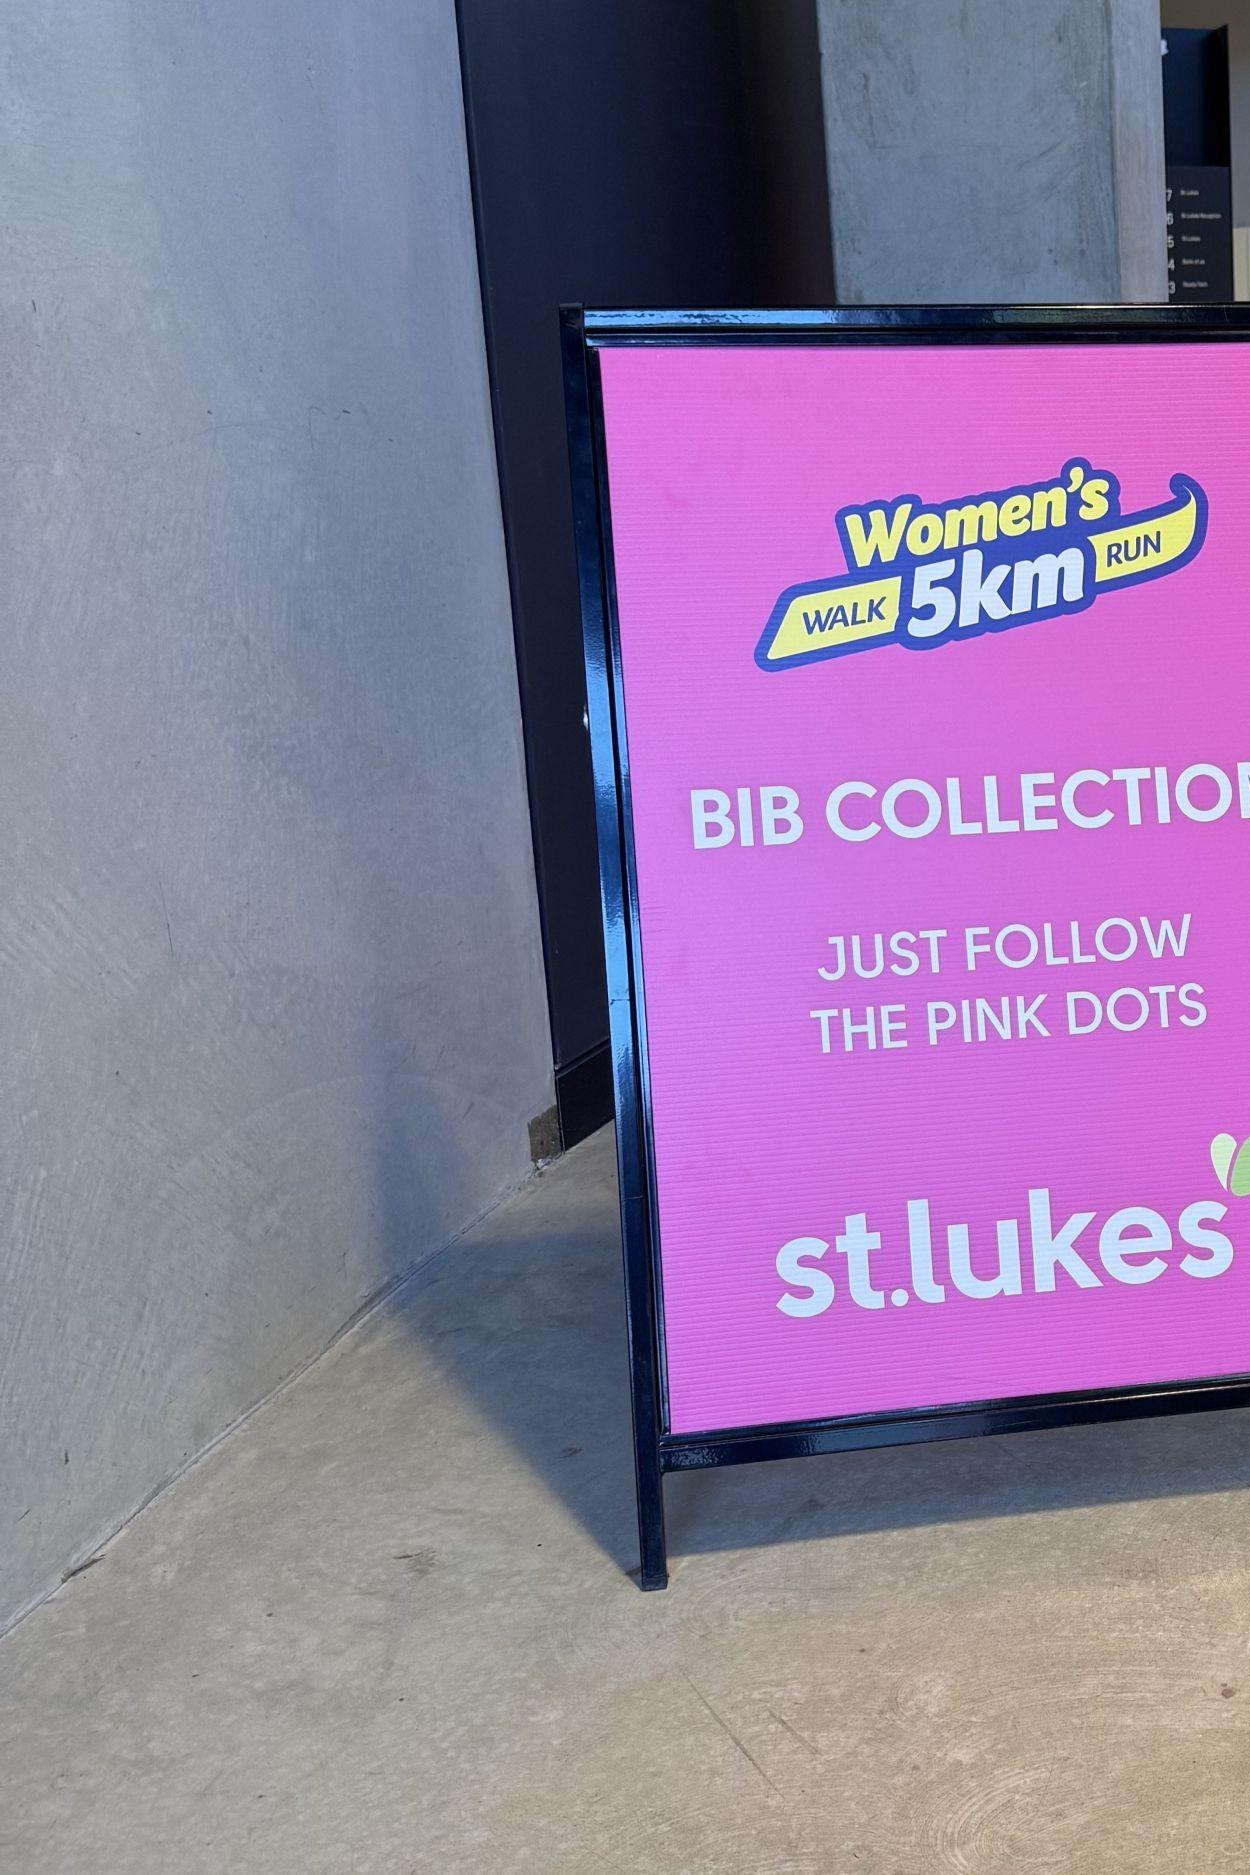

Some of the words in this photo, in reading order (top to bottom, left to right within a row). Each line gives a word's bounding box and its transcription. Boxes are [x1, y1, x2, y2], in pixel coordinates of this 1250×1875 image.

[1166, 189, 1173, 202] 7
[1167, 212, 1174, 225] 6
[1167, 235, 1175, 248] 5
[1168, 258, 1175, 271] 4
[1168, 281, 1176, 294] 3
[845, 467, 1110, 568] Women's
[802, 596, 887, 635] WALK
[907, 550, 1085, 638] 5km
[1106, 531, 1162, 567] RUN
[689, 785, 805, 850] BIB
[817, 929, 948, 981] JUST
[964, 913, 1192, 971] FOLLOW
[809, 1004, 909, 1053] THE
[926, 993, 1052, 1046] PINK
[1066, 982, 1208, 1034] DOTS
[775, 1187, 1235, 1318] st.lukes
